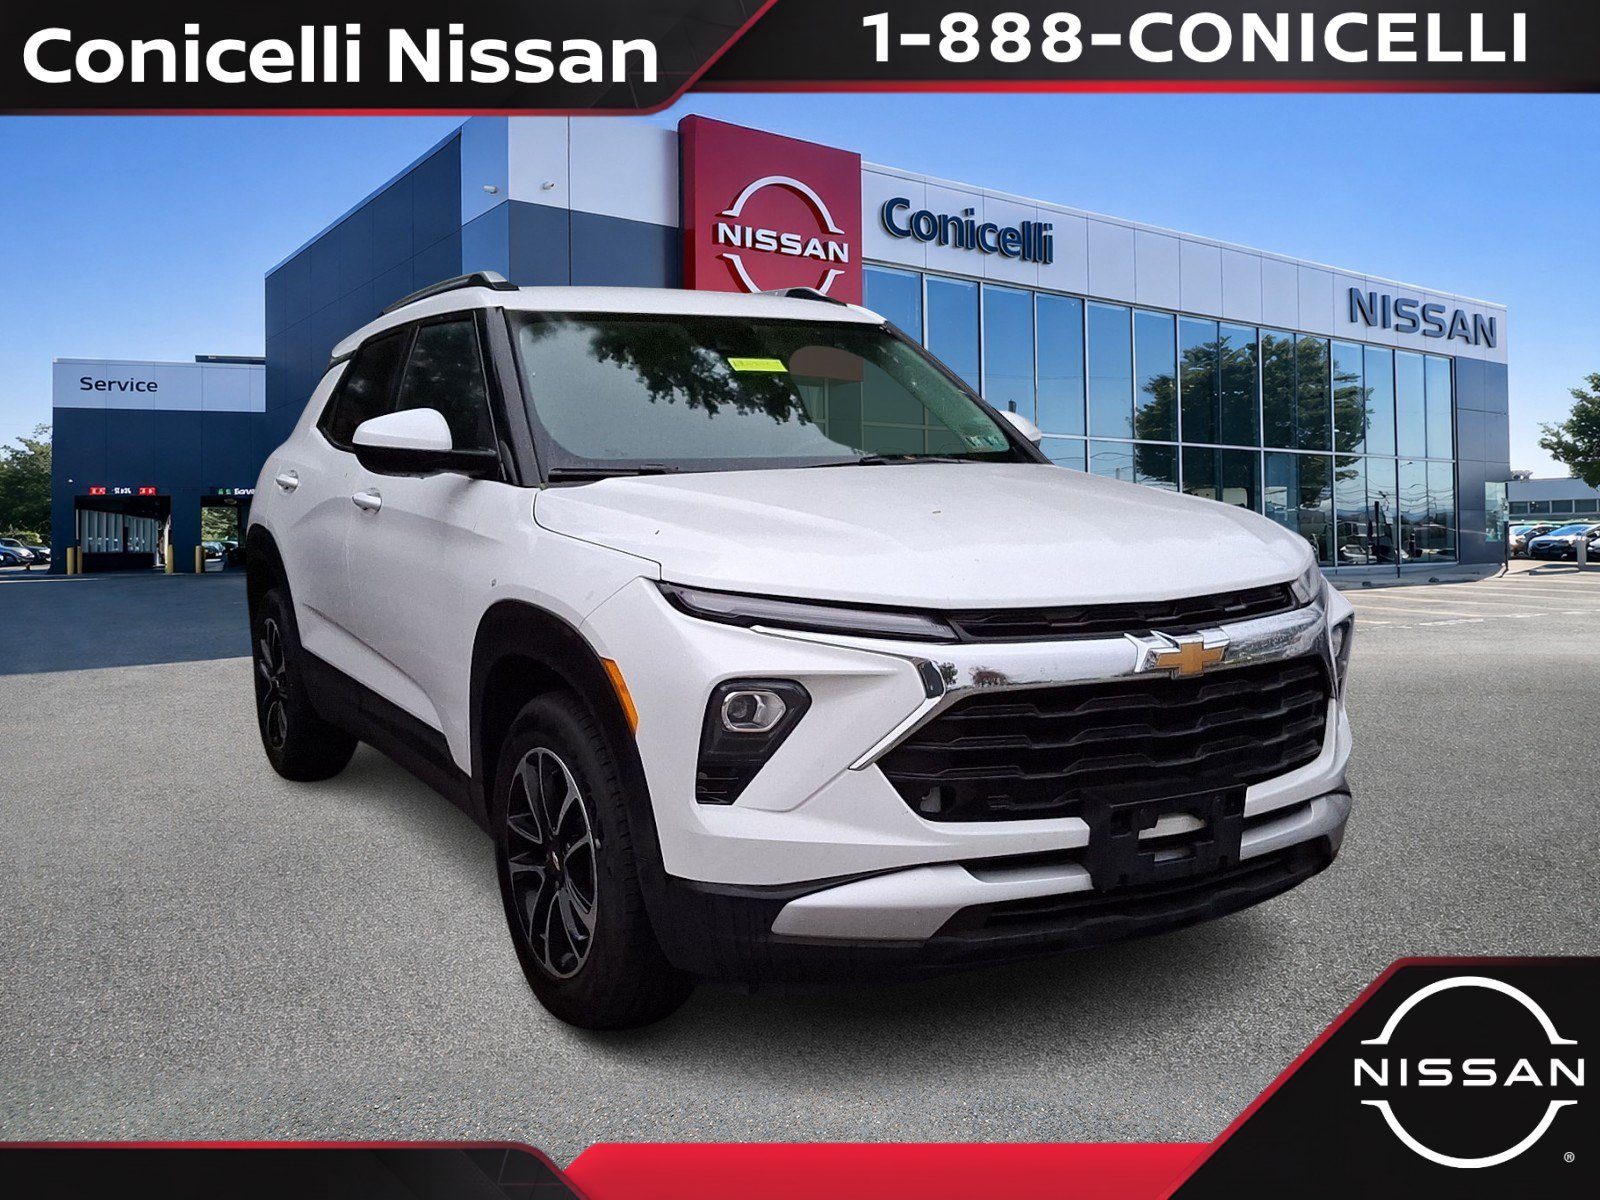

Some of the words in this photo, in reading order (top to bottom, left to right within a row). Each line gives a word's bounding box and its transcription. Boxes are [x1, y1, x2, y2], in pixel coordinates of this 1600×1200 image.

[716, 222, 849, 263] NISSAN
[882, 197, 1054, 264] Conicelli
[1349, 287, 1497, 348] NISSAN
[80, 376, 158, 393] Service
